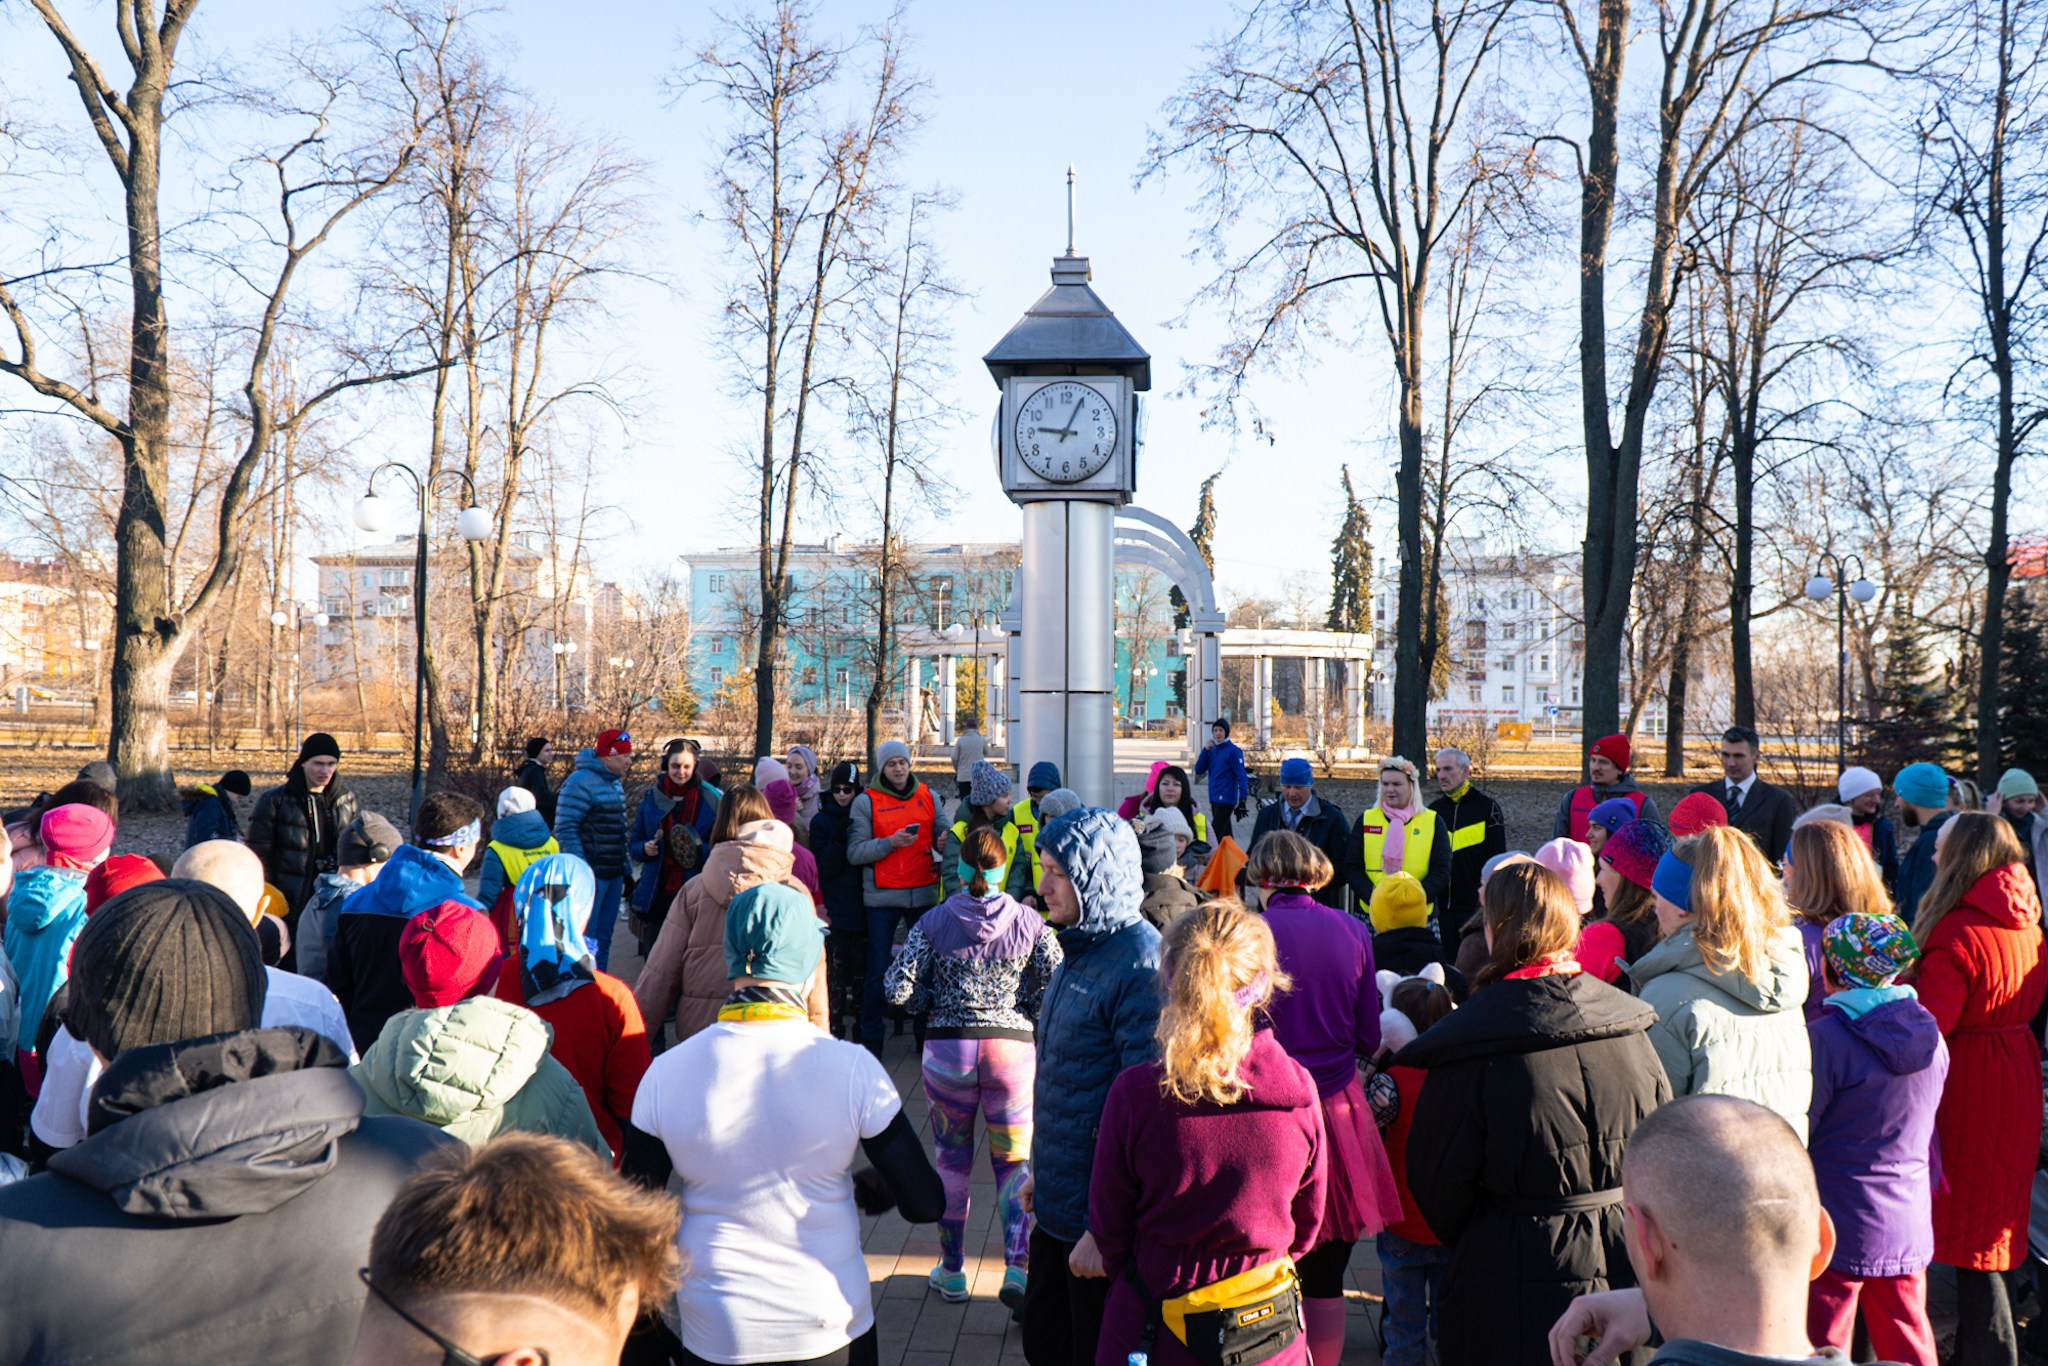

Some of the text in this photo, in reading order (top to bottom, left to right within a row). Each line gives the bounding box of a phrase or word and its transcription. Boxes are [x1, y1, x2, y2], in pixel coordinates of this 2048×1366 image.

[1045, 397, 1053, 409] 11
[1060, 391, 1073, 404] 12
[1030, 409, 1042, 421] 10
[1092, 409, 1100, 421] 2
[1027, 427, 1035, 439] 9
[1097, 426, 1105, 439] 3
[1032, 444, 1040, 456] 8
[1092, 444, 1100, 456] 4
[1045, 457, 1052, 469] 7
[1062, 461, 1070, 473] 6
[1080, 457, 1087, 469] 5
